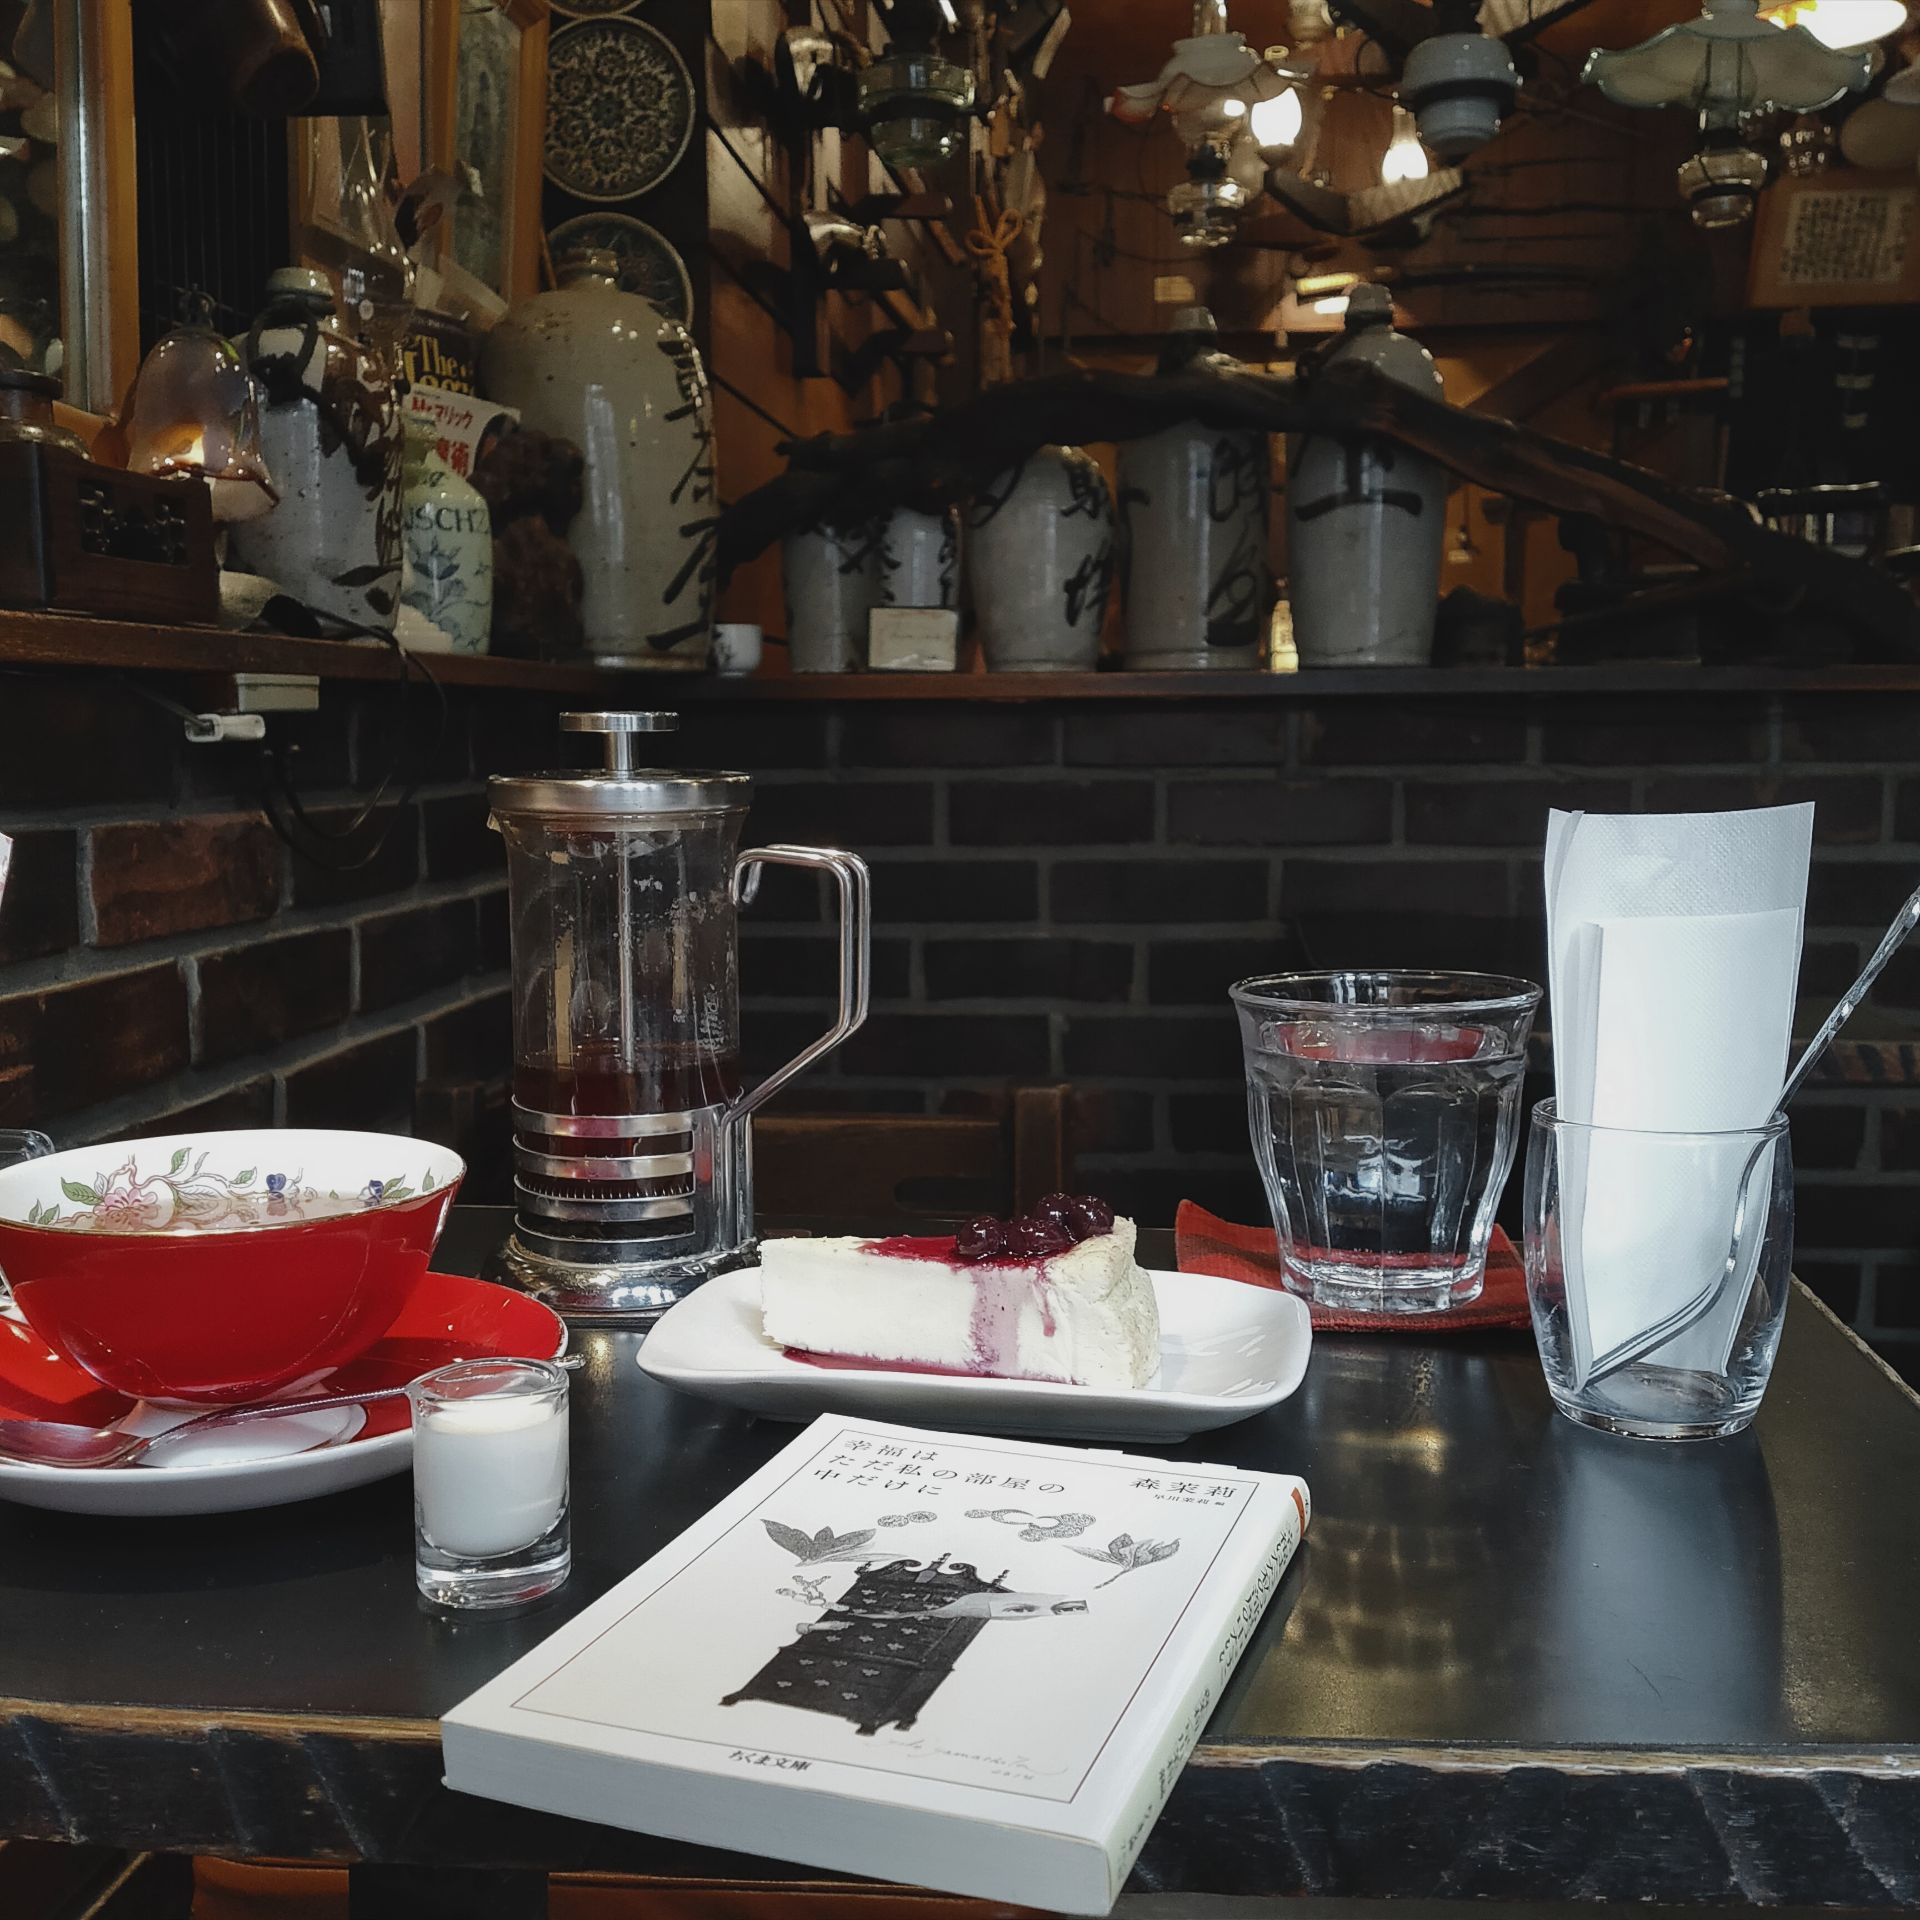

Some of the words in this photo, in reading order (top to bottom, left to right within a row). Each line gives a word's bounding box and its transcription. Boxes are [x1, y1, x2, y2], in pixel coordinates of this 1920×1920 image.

[415, 335, 458, 377] The
[844, 1439, 939, 1462] 幸福は
[814, 1469, 943, 1496] 中だけに
[829, 1454, 1065, 1494] ただ私の部屋の
[1129, 1477, 1237, 1499] 森茉莉
[728, 1749, 812, 1772] ちくま文庫
